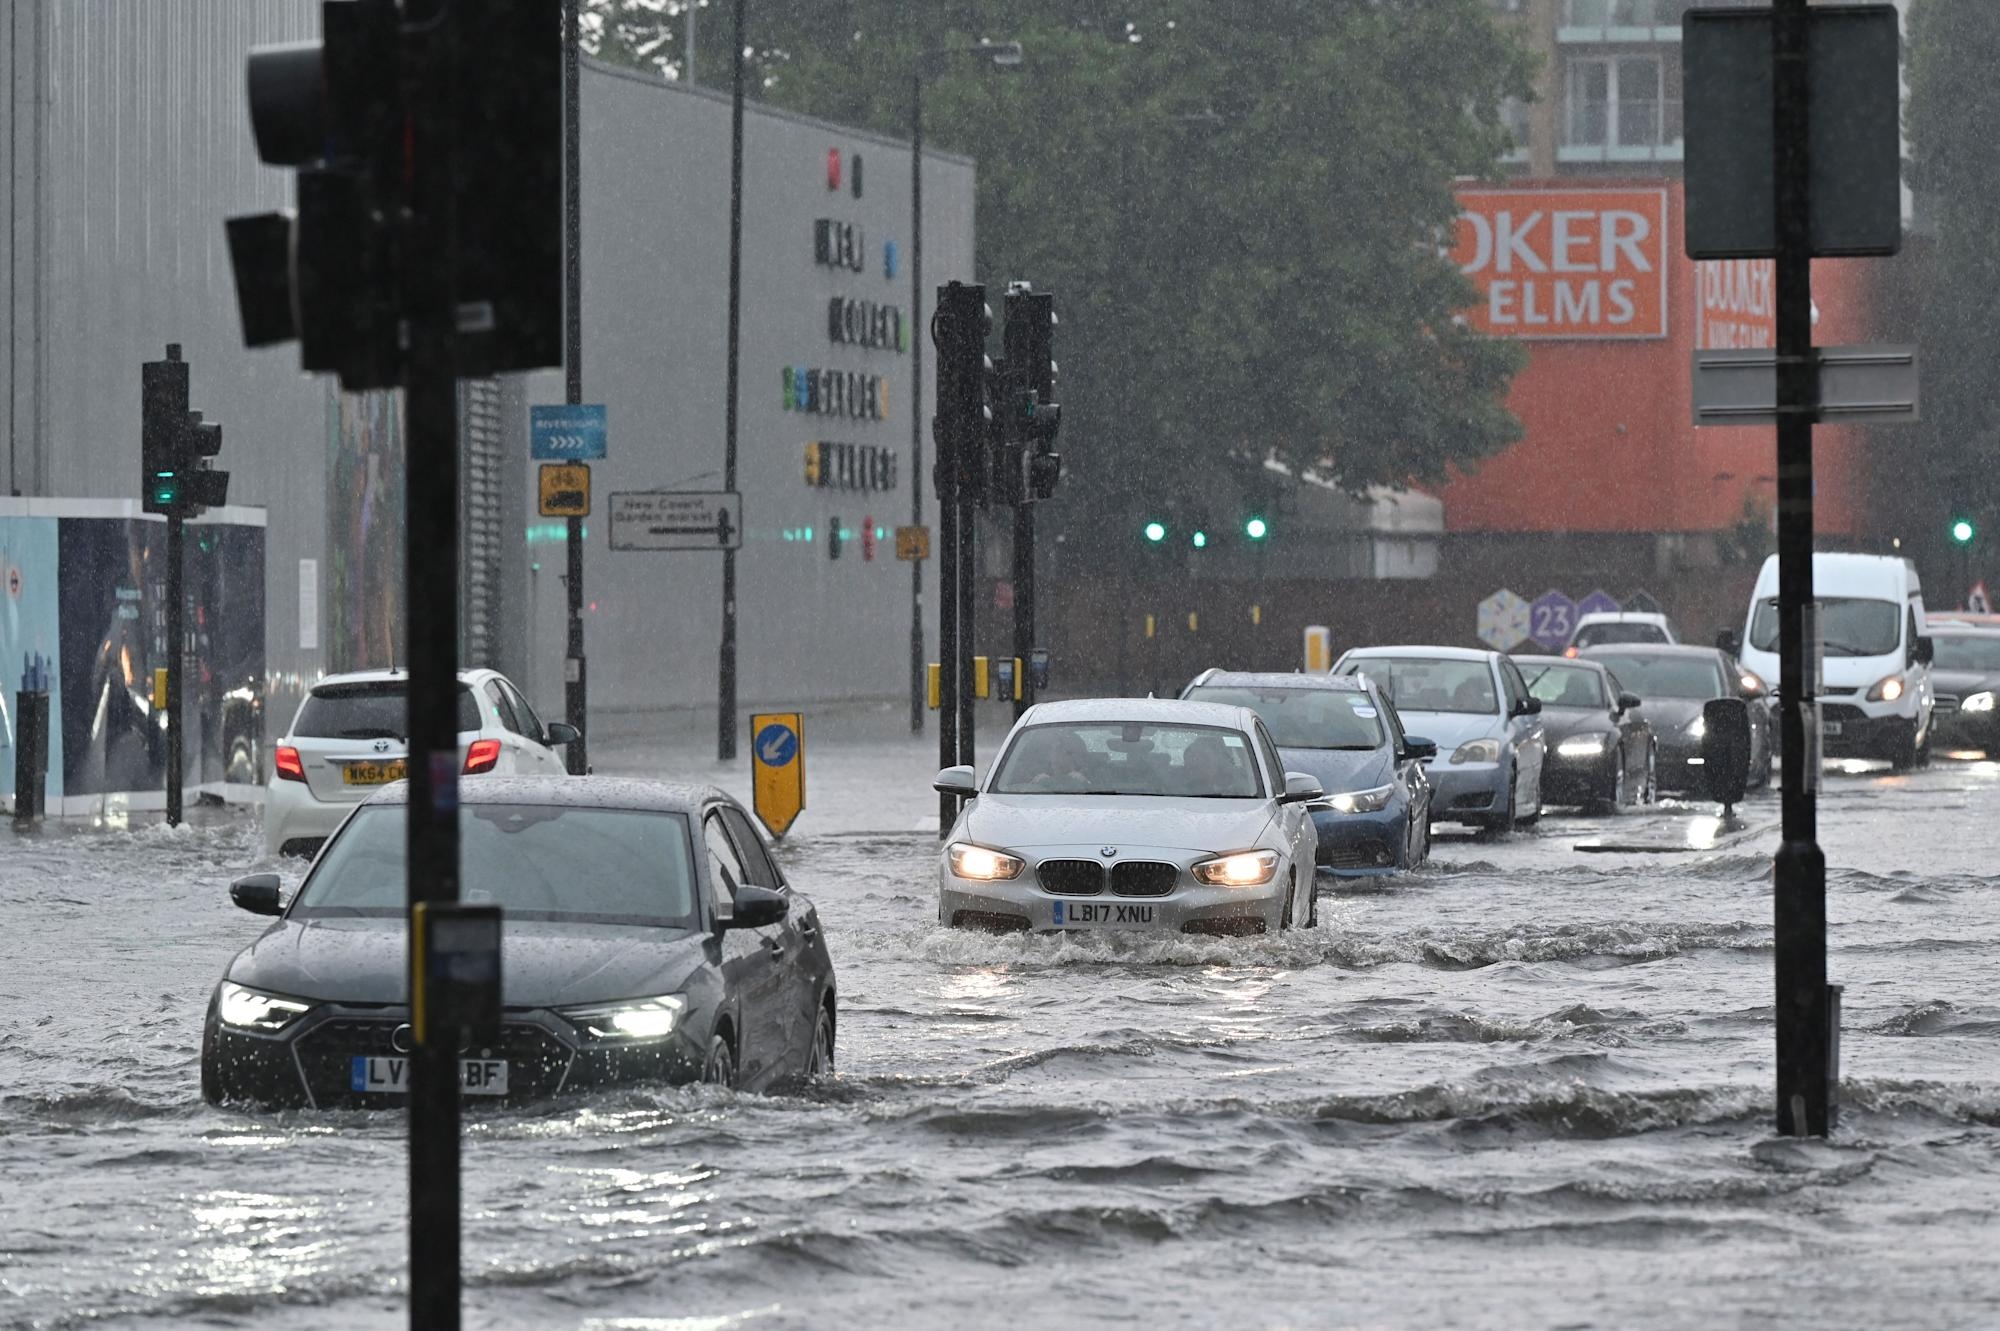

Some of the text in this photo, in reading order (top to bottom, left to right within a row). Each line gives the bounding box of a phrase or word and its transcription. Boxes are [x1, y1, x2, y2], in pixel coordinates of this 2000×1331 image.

[1488, 278, 1636, 325] ELMS
[1536, 605, 1570, 638] 23
[389, 765, 408, 779] CK
[1069, 904, 1153, 923] LB17 XNU
[369, 1059, 500, 1087] LV BF
